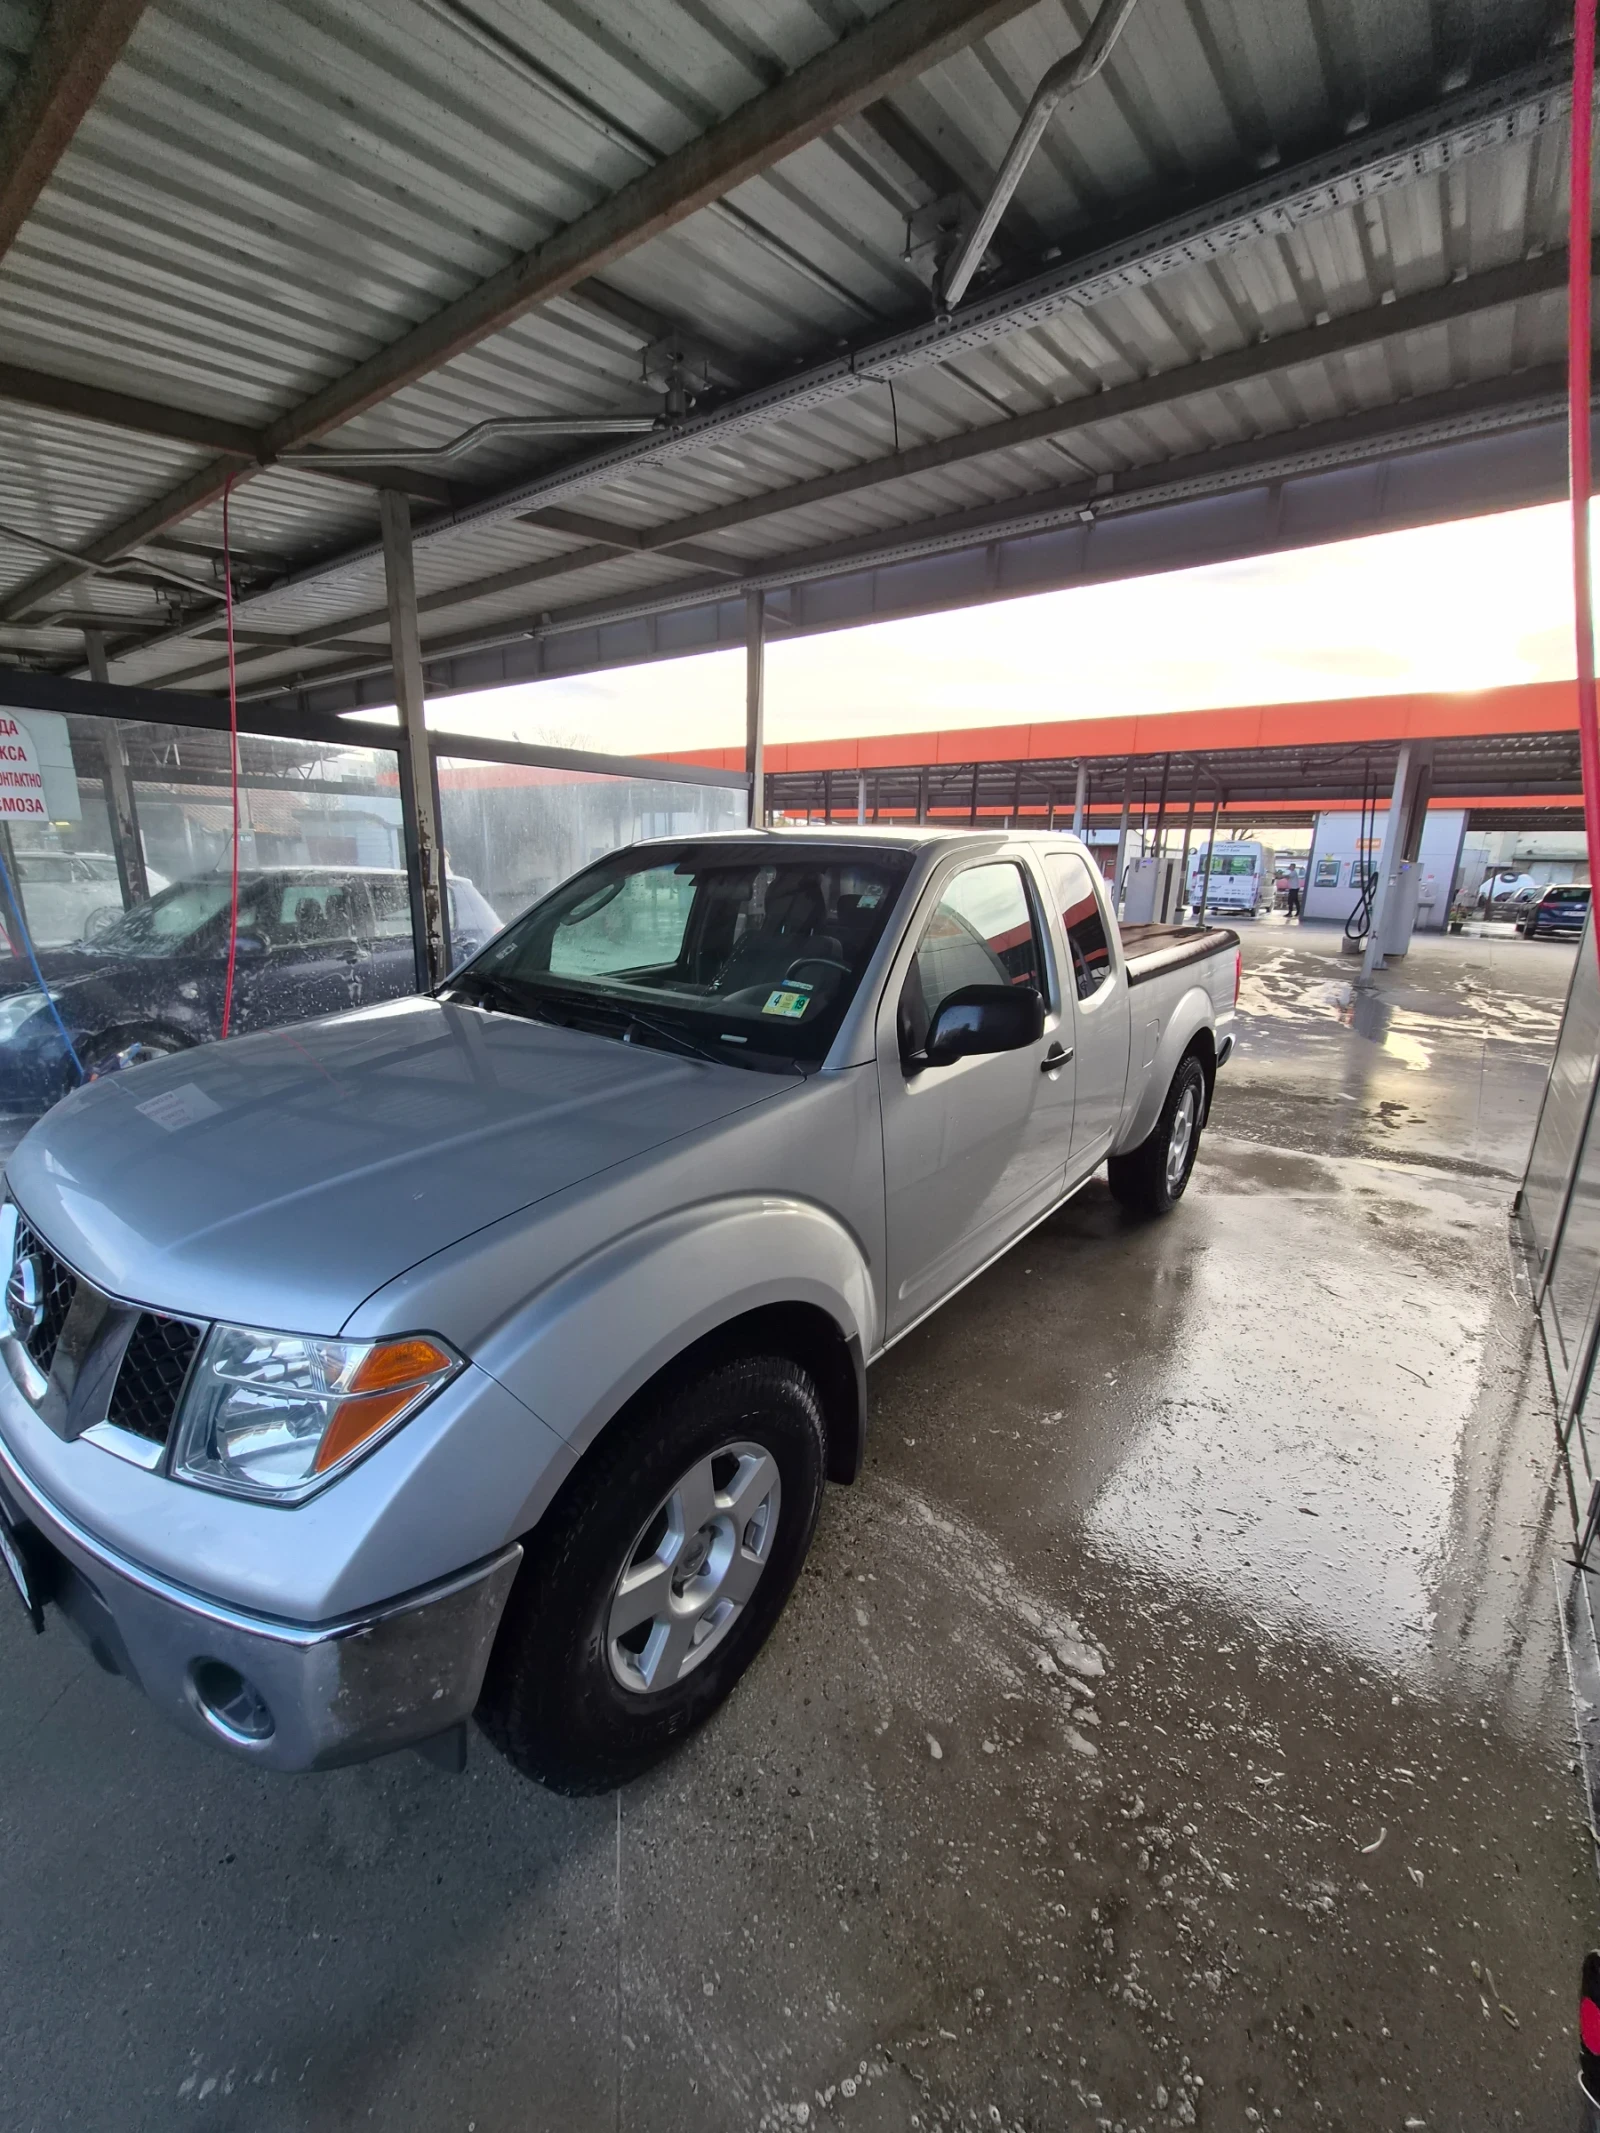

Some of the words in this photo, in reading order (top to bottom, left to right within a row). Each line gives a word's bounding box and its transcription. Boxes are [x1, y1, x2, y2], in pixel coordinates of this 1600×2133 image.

[0, 797, 44, 813] МОЗА
[774, 994, 782, 1006] 4
[794, 998, 806, 1010] 19
